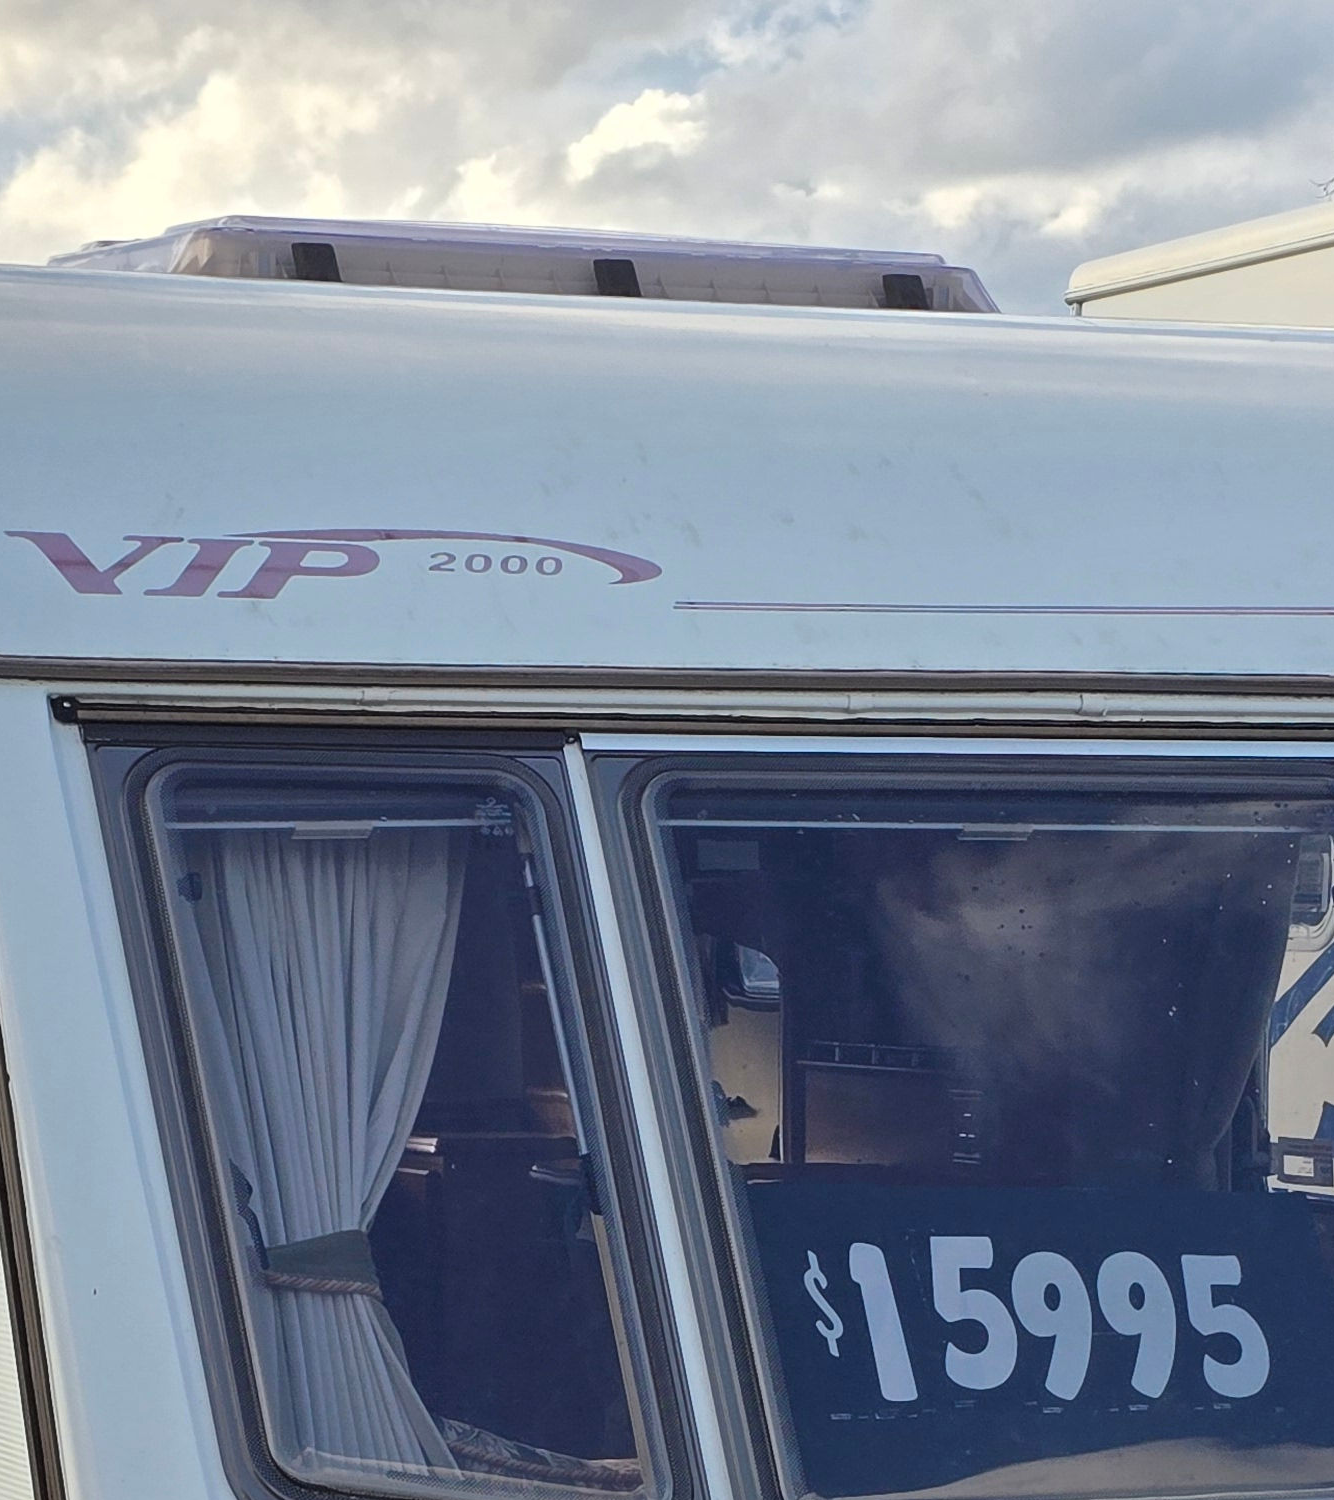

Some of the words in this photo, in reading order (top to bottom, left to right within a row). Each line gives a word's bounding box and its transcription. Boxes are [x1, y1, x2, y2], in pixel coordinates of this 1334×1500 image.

[4, 531, 380, 599] VIP
[428, 551, 563, 576] 2000
[803, 1236, 1270, 1401] $15995
